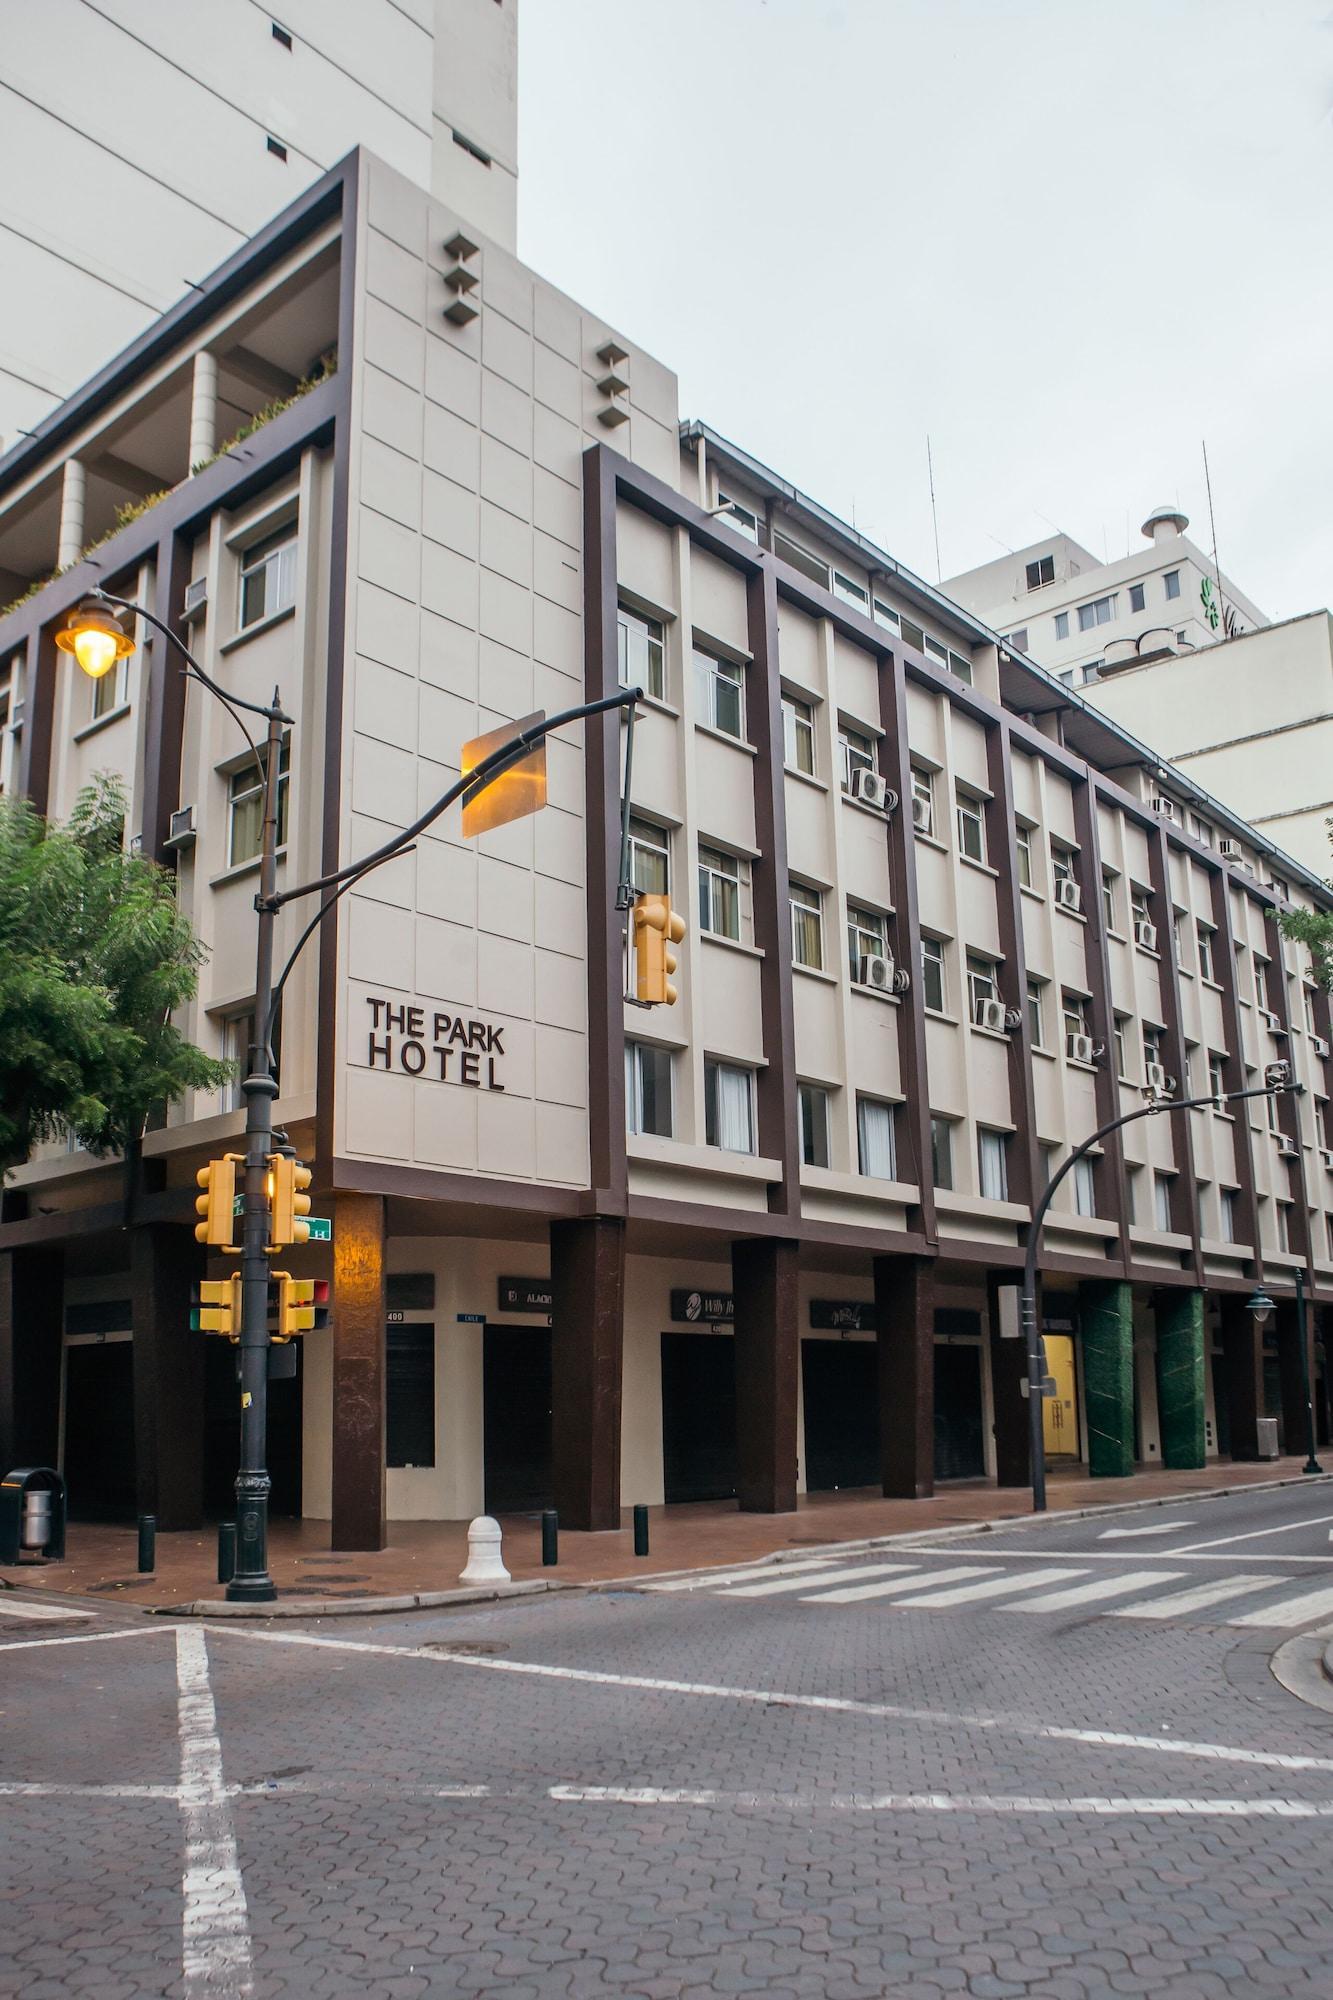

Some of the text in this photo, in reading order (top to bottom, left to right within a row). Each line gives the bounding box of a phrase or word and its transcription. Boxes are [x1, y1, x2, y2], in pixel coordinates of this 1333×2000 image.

[366, 997, 505, 1055] THE PARK
[368, 1032, 505, 1092] HOTEL
[387, 1312, 403, 1321] 400
